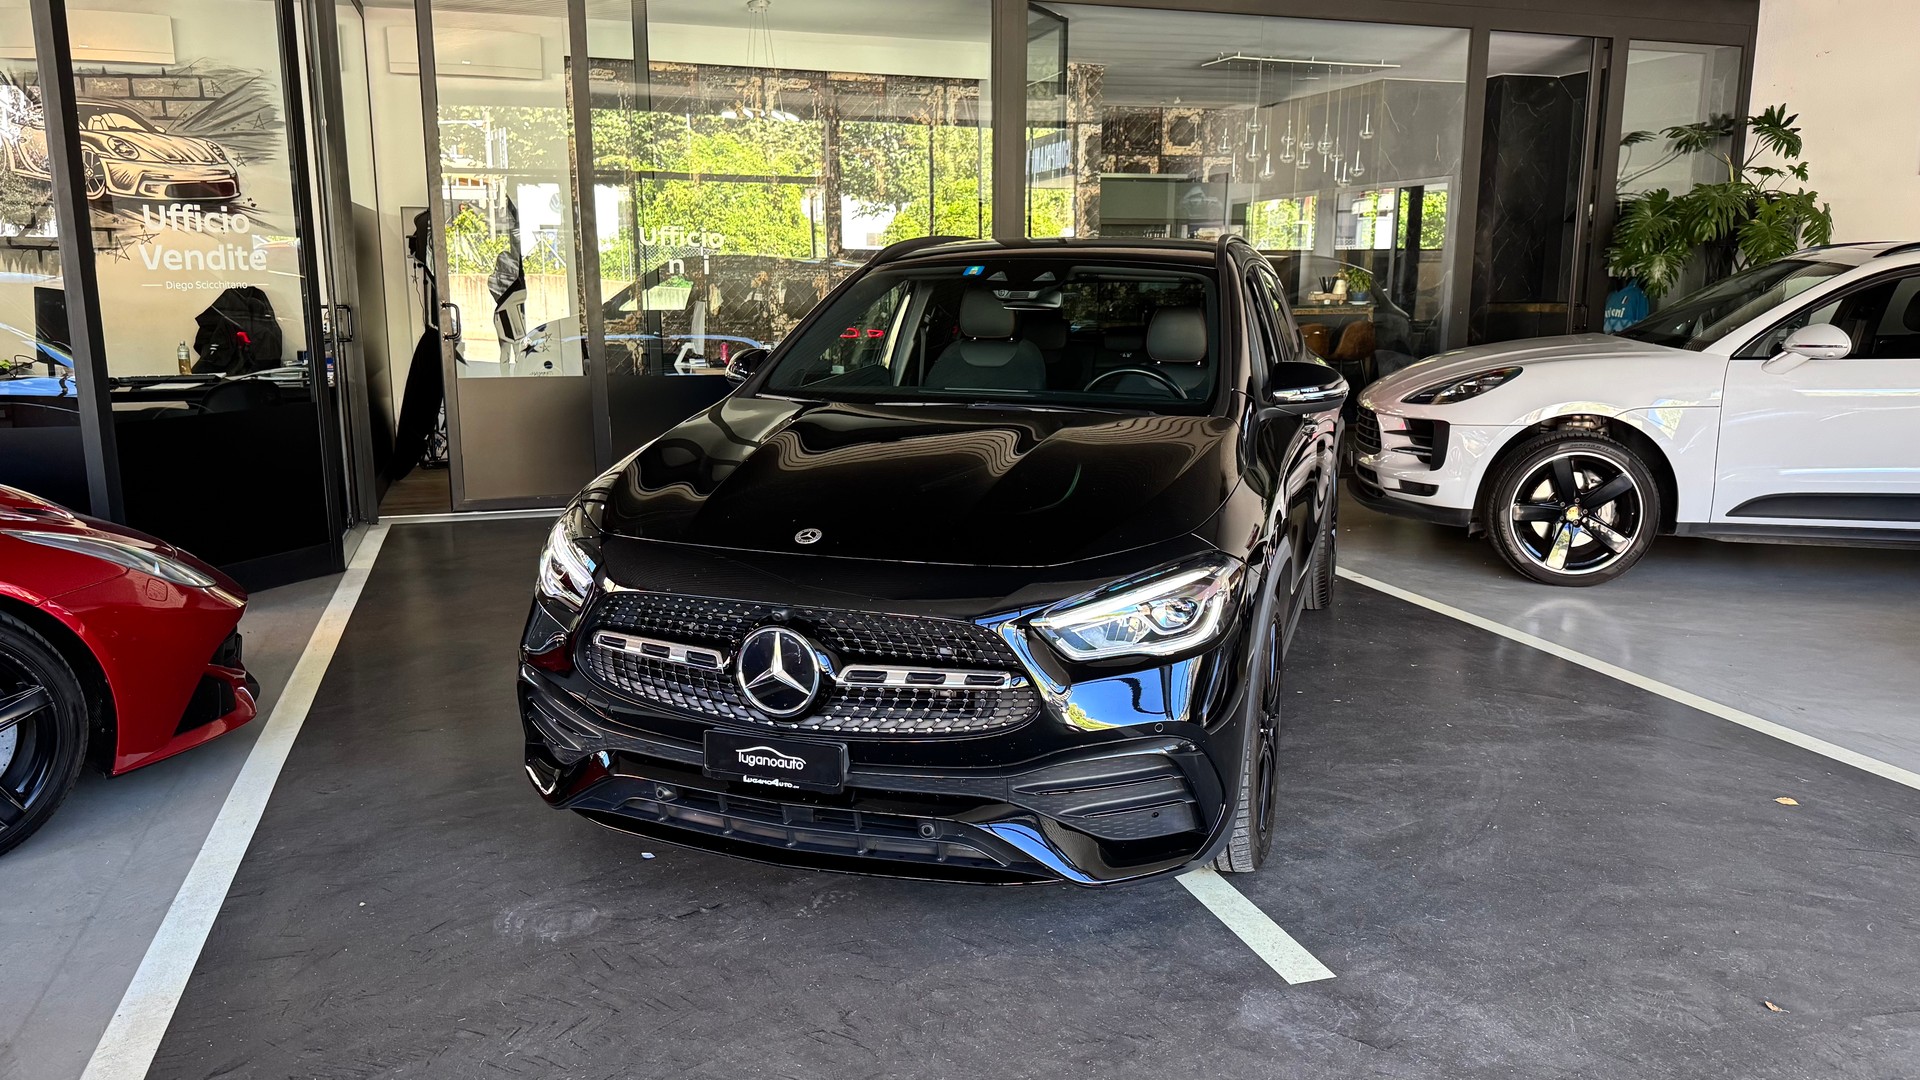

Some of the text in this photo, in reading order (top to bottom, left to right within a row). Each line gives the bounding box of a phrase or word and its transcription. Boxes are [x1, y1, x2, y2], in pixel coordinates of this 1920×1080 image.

[142, 203, 250, 234] Ufficio
[639, 226, 725, 249] Ufficio
[138, 243, 267, 271] Vendite
[166, 281, 193, 291] Diego
